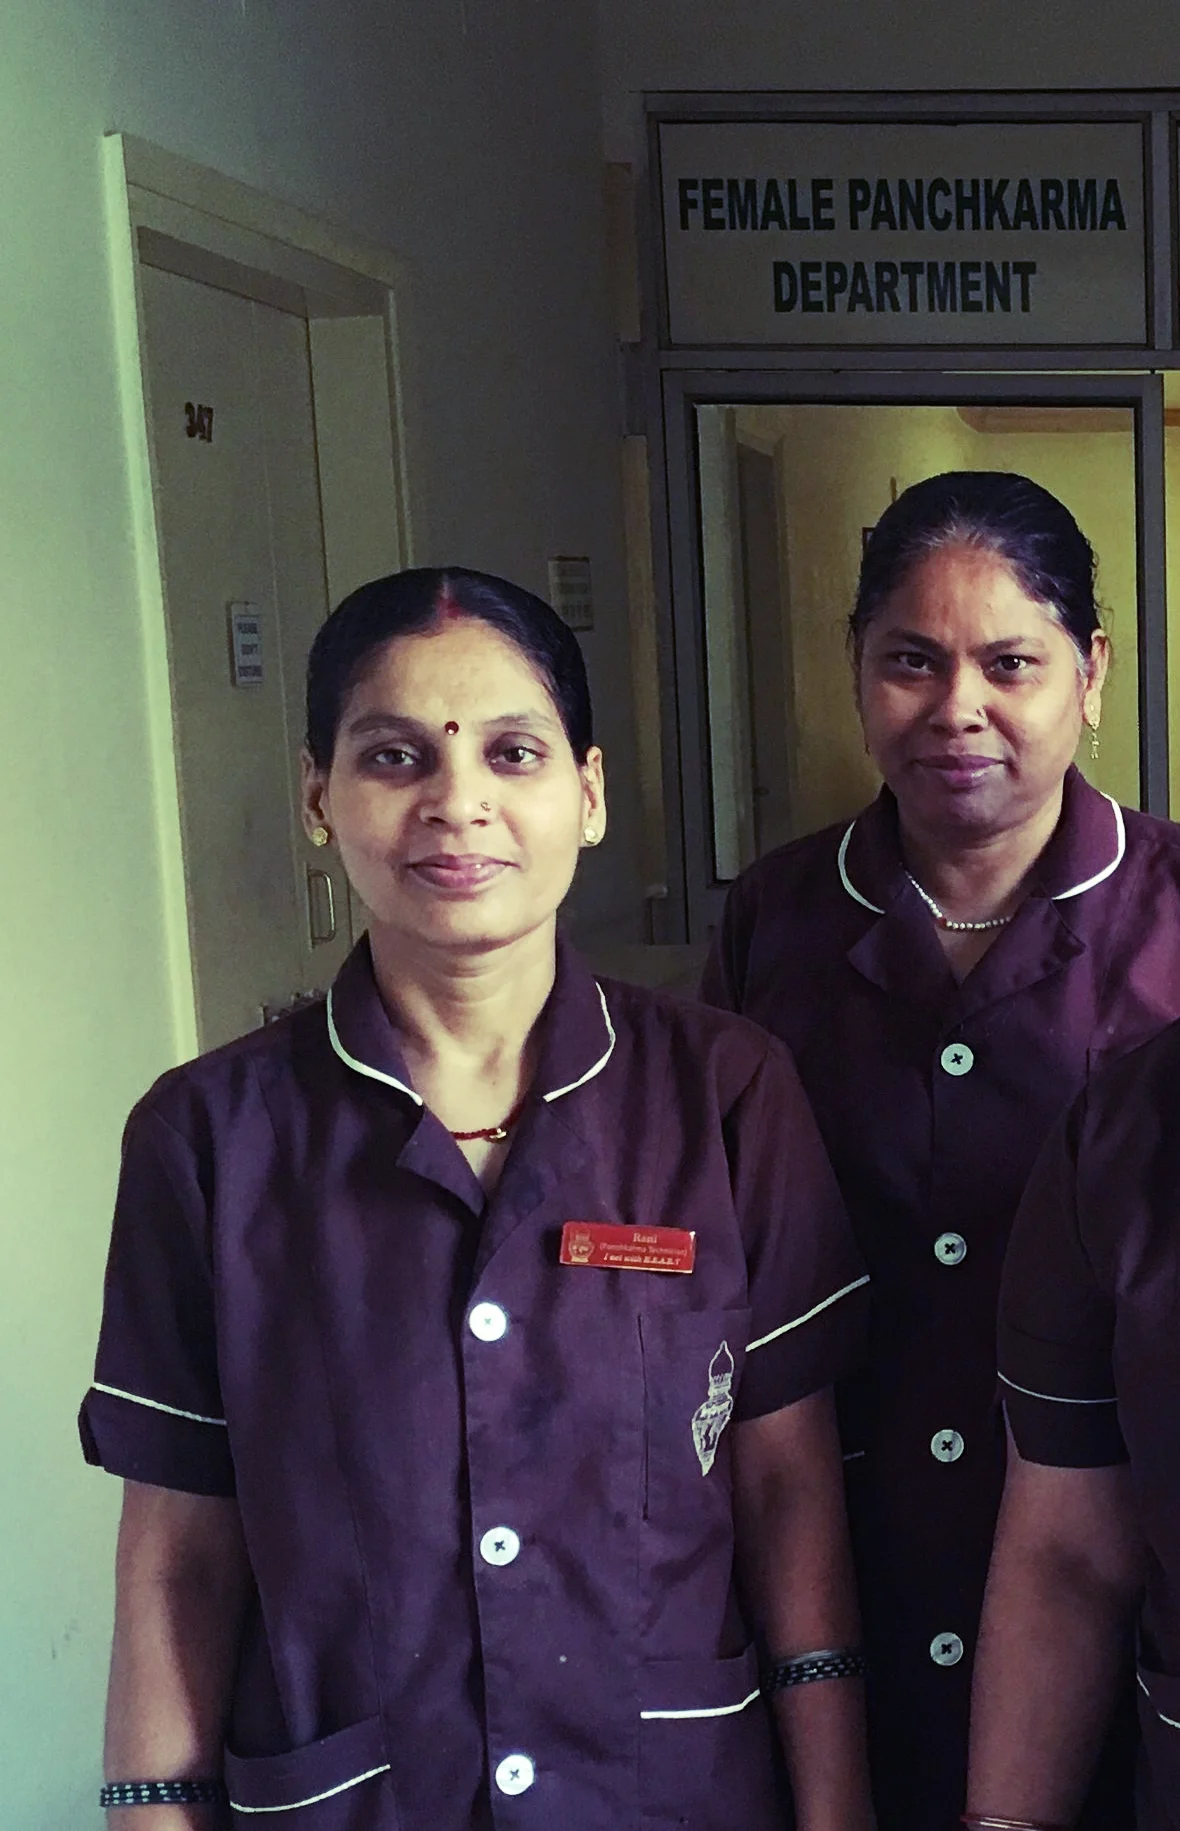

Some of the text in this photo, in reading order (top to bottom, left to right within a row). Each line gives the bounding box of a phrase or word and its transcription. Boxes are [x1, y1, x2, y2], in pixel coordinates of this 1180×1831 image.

[677, 177, 1127, 231] FEMALE PANCHKARMA
[772, 261, 1038, 313] DEPARTMENT
